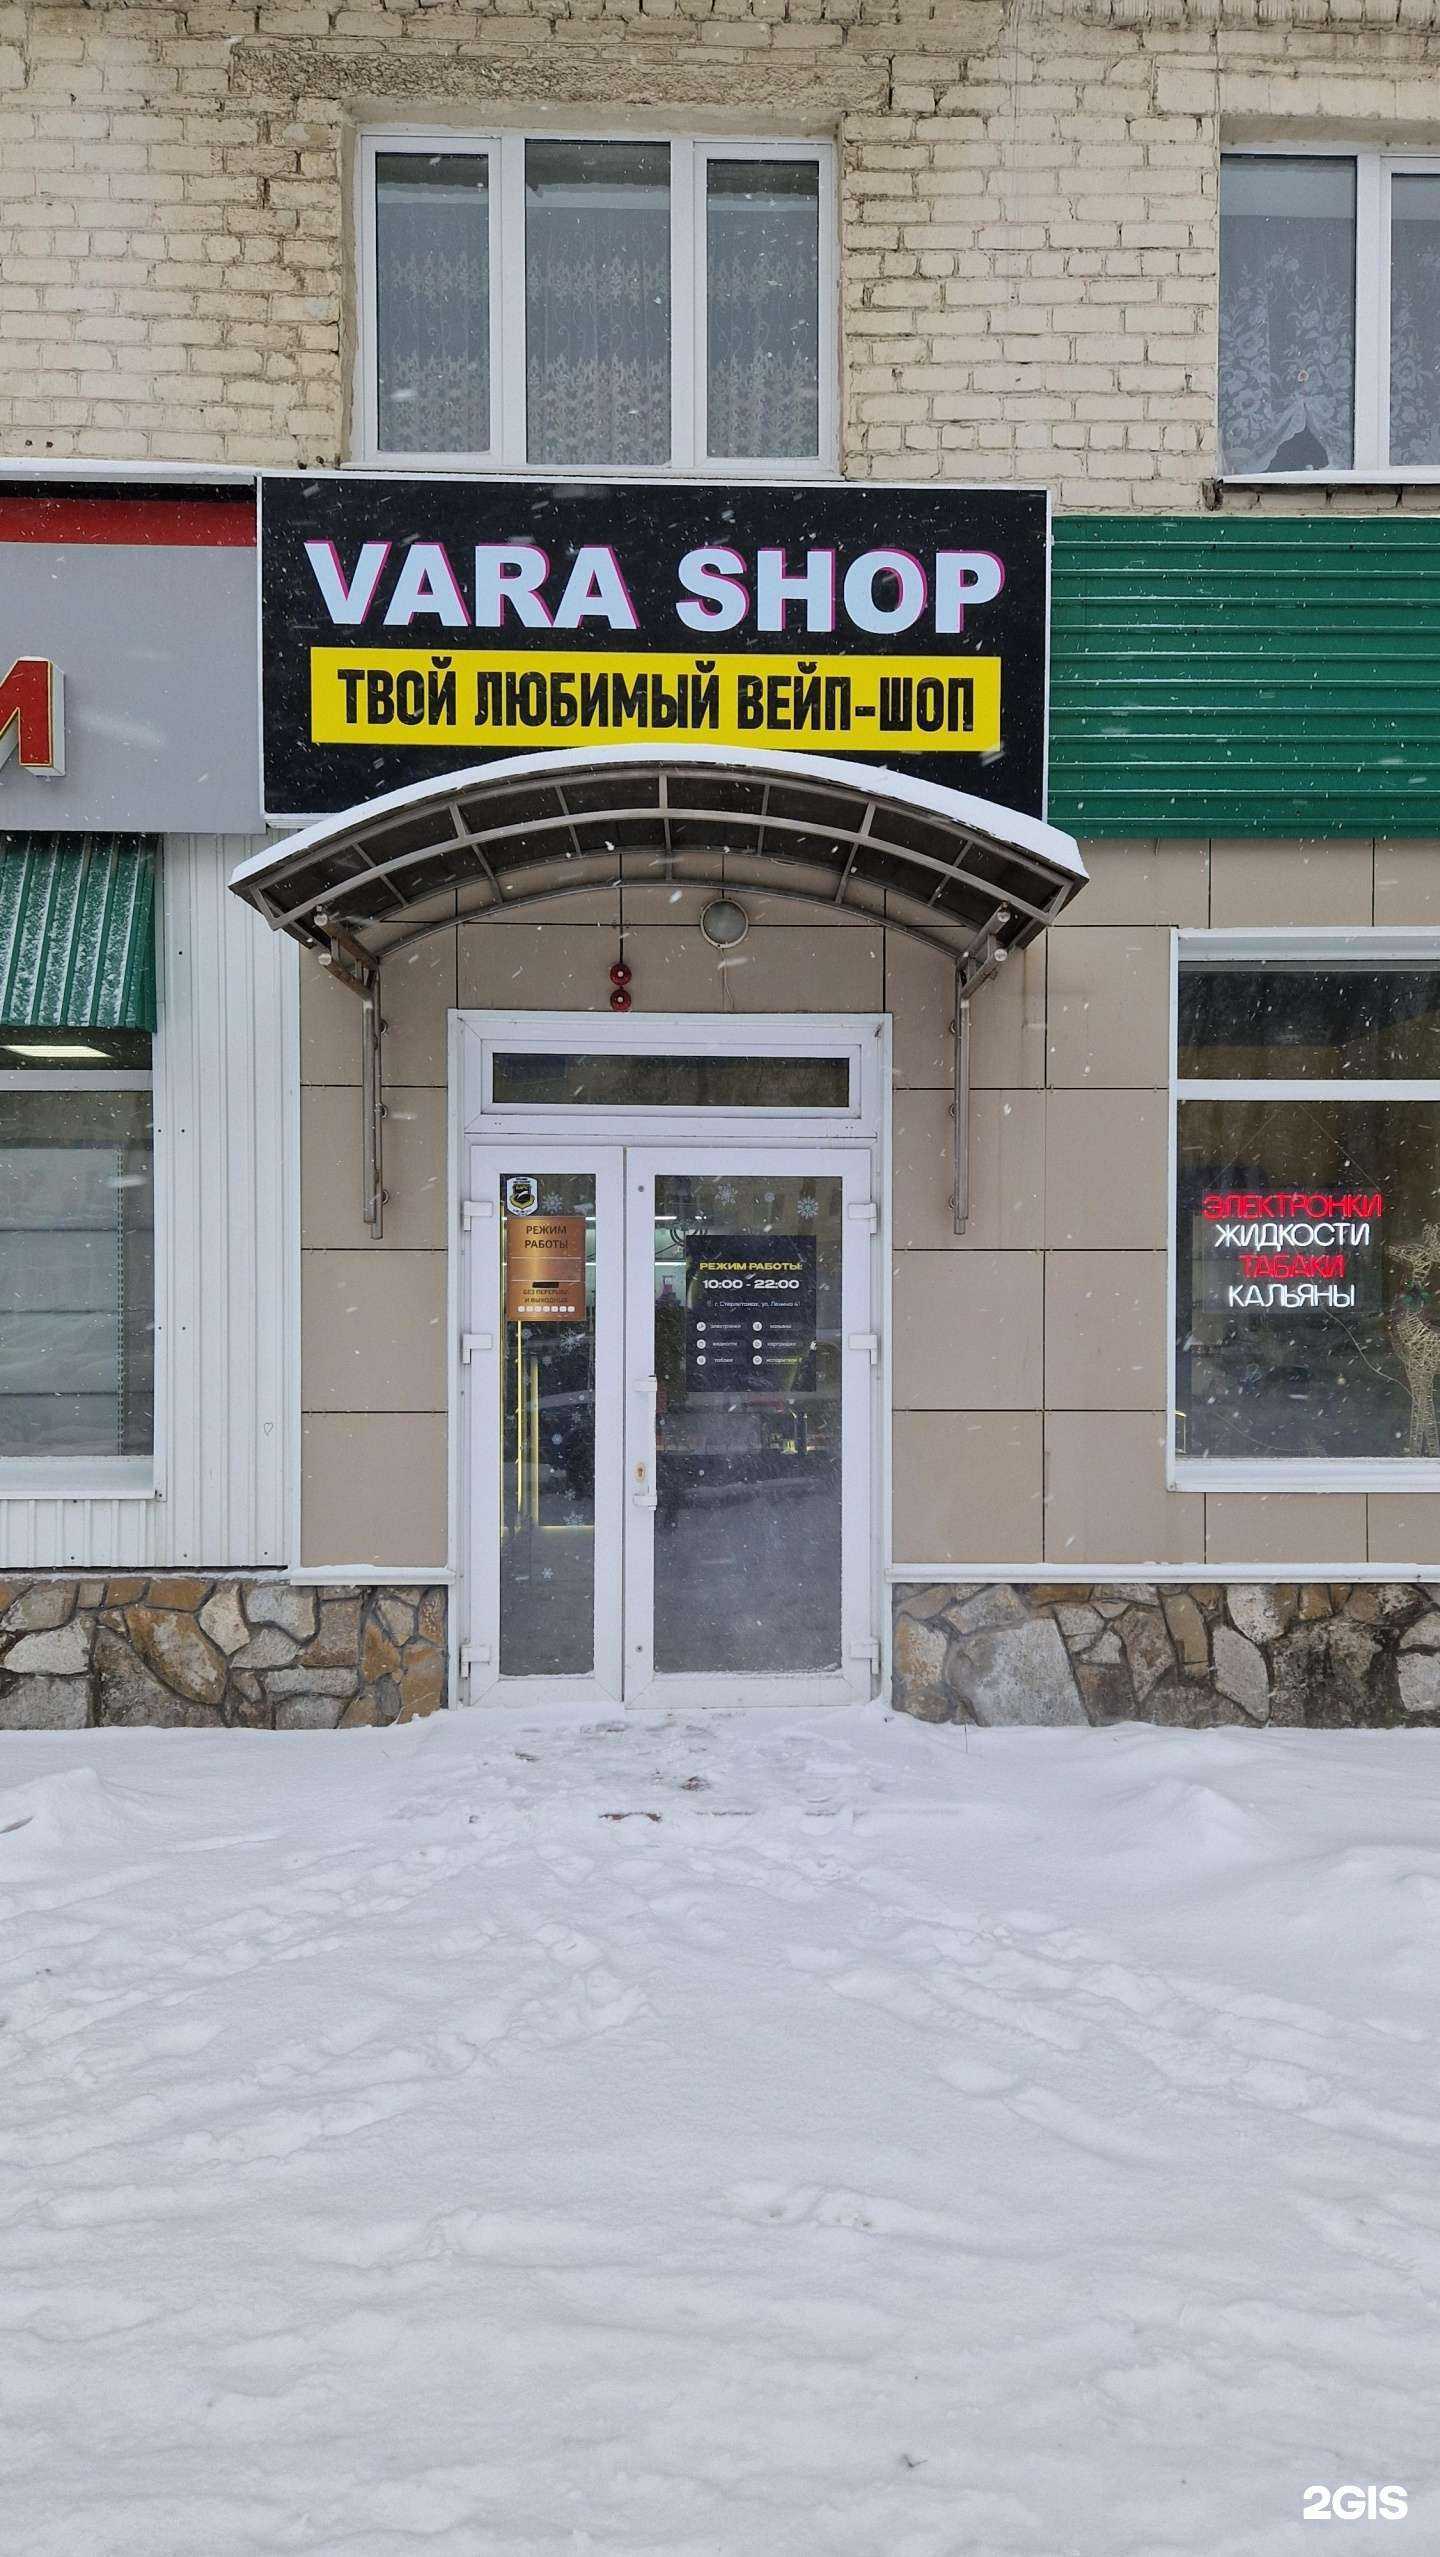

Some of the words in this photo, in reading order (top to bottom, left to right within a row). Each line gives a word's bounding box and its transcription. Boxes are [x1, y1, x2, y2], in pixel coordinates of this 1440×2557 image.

[304, 541, 640, 630] VARA
[676, 545, 1006, 635] SHOP
[337, 655, 457, 727] ТВОЙ
[474, 660, 721, 730] ЛЮБИМЫЙ
[737, 661, 975, 733] ВЕЙП-ШОП
[1203, 1191, 1383, 1221] ЭЛЕКТРОНКИ
[526, 1225, 568, 1235] РЕЖИМ
[1214, 1222, 1370, 1252] ЖИДКОСТИ
[524, 1239, 569, 1249] РАБОТЫ
[700, 1262, 746, 1271] РЕЖИМ
[1239, 1253, 1346, 1278] ТАБАКИ
[703, 1279, 743, 1289] 10:00
[754, 1279, 800, 1289] 22:00
[1228, 1284, 1356, 1308] КАЛЬЯНЫ
